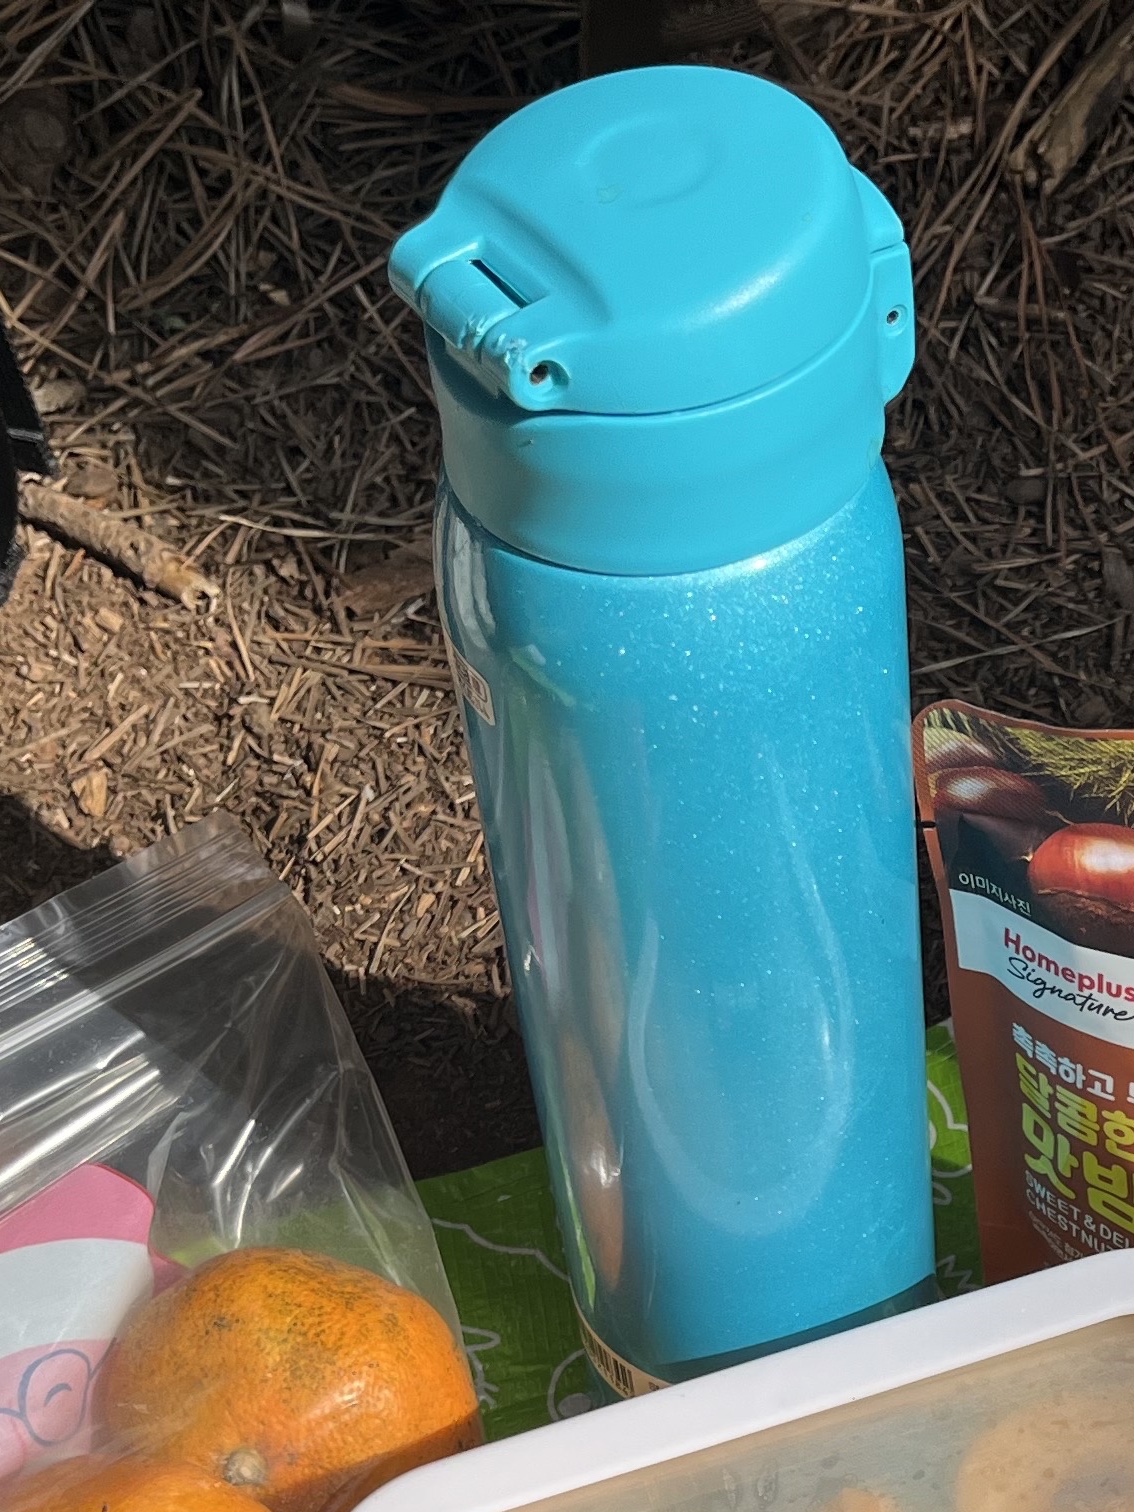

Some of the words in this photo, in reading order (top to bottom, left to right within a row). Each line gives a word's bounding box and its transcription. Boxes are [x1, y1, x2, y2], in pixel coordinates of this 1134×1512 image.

[958, 872, 1032, 917] 이미지사진
[1012, 1022, 1116, 1102] 촉촉하고
[1025, 1170, 1081, 1223] SWEET
[1083, 1214, 1098, 1233] &
